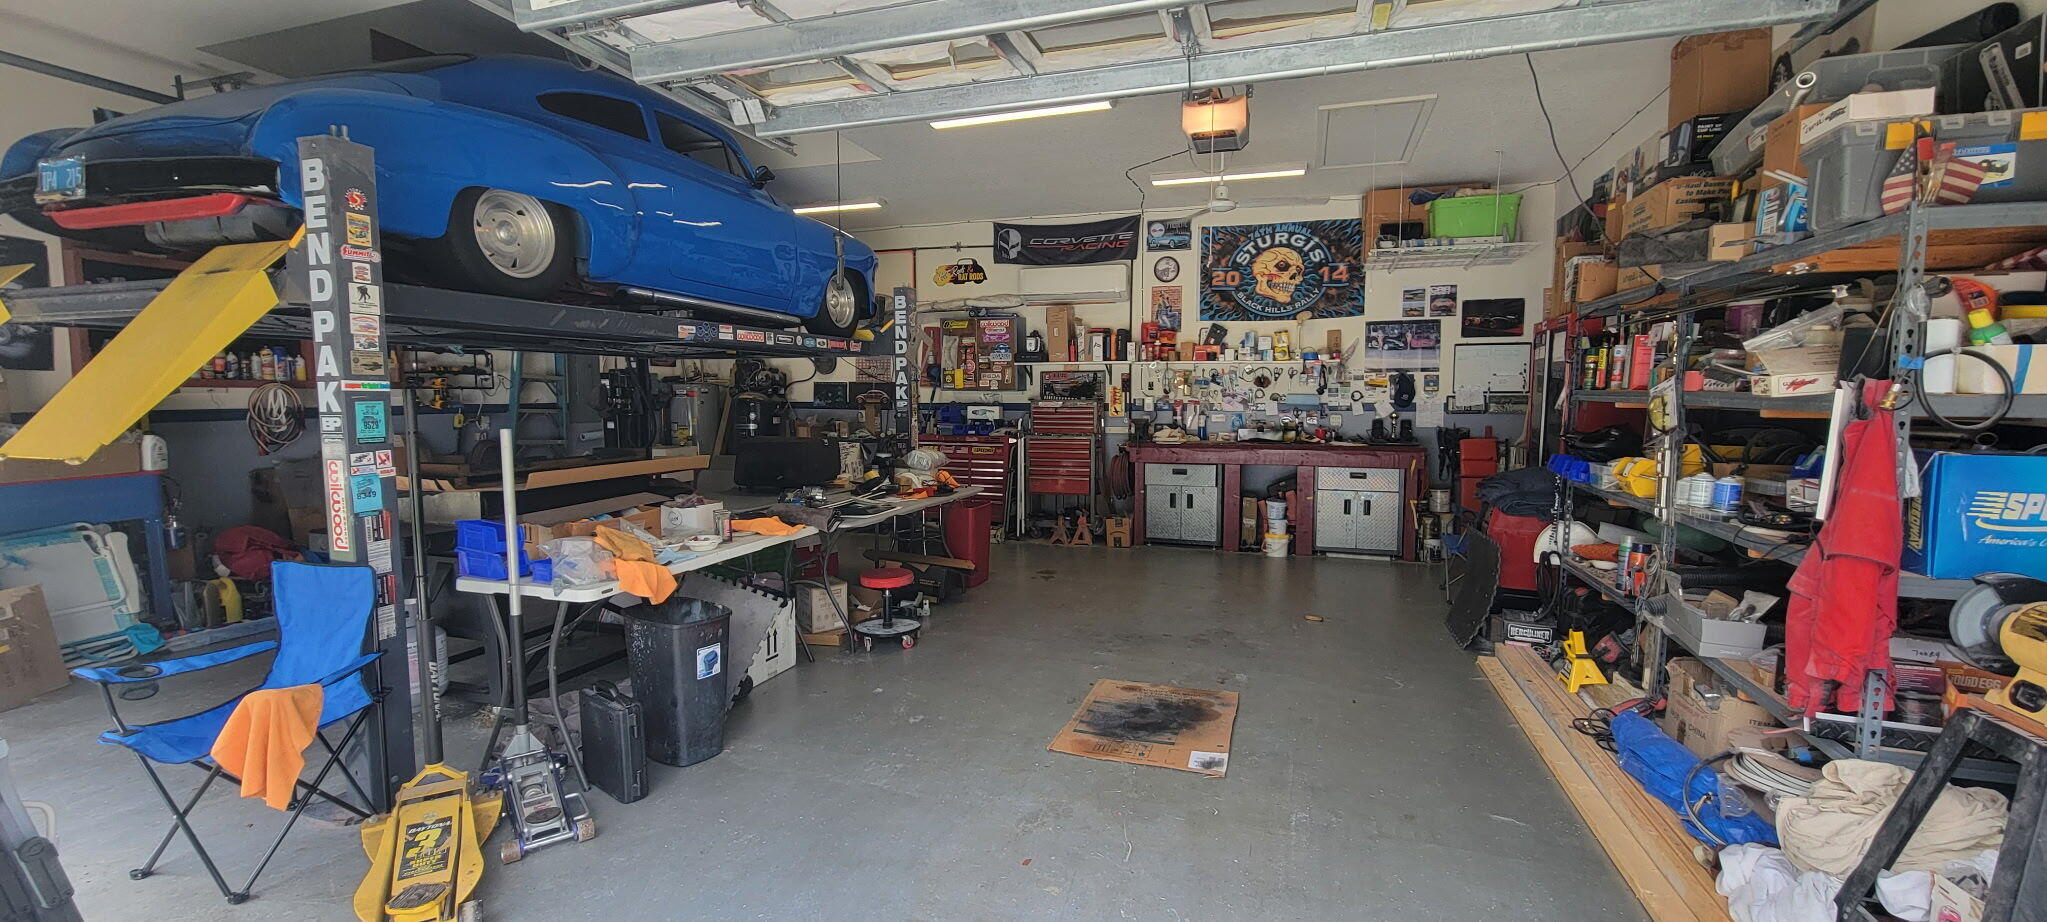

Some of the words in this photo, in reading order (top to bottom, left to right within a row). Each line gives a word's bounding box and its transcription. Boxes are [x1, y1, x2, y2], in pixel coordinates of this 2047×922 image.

[1030, 231, 1134, 245] CORVETTE
[1275, 223, 1313, 237] ANNUAL
[1060, 240, 1130, 251] RACING
[1236, 232, 1324, 266] STURGIS
[301, 158, 344, 412] BENDPAK
[1211, 271, 1241, 286] 20
[1318, 265, 1349, 282] 14
[1237, 291, 1262, 311] BLACK
[1264, 305, 1293, 313] HILLS
[1294, 288, 1320, 309] RALLY
[894, 296, 908, 400] BENDPAK
[328, 461, 348, 550] wilwood
[1978, 535, 2035, 546] America's
[408, 820, 451, 833] DAYTONA
[405, 827, 442, 858] 3
